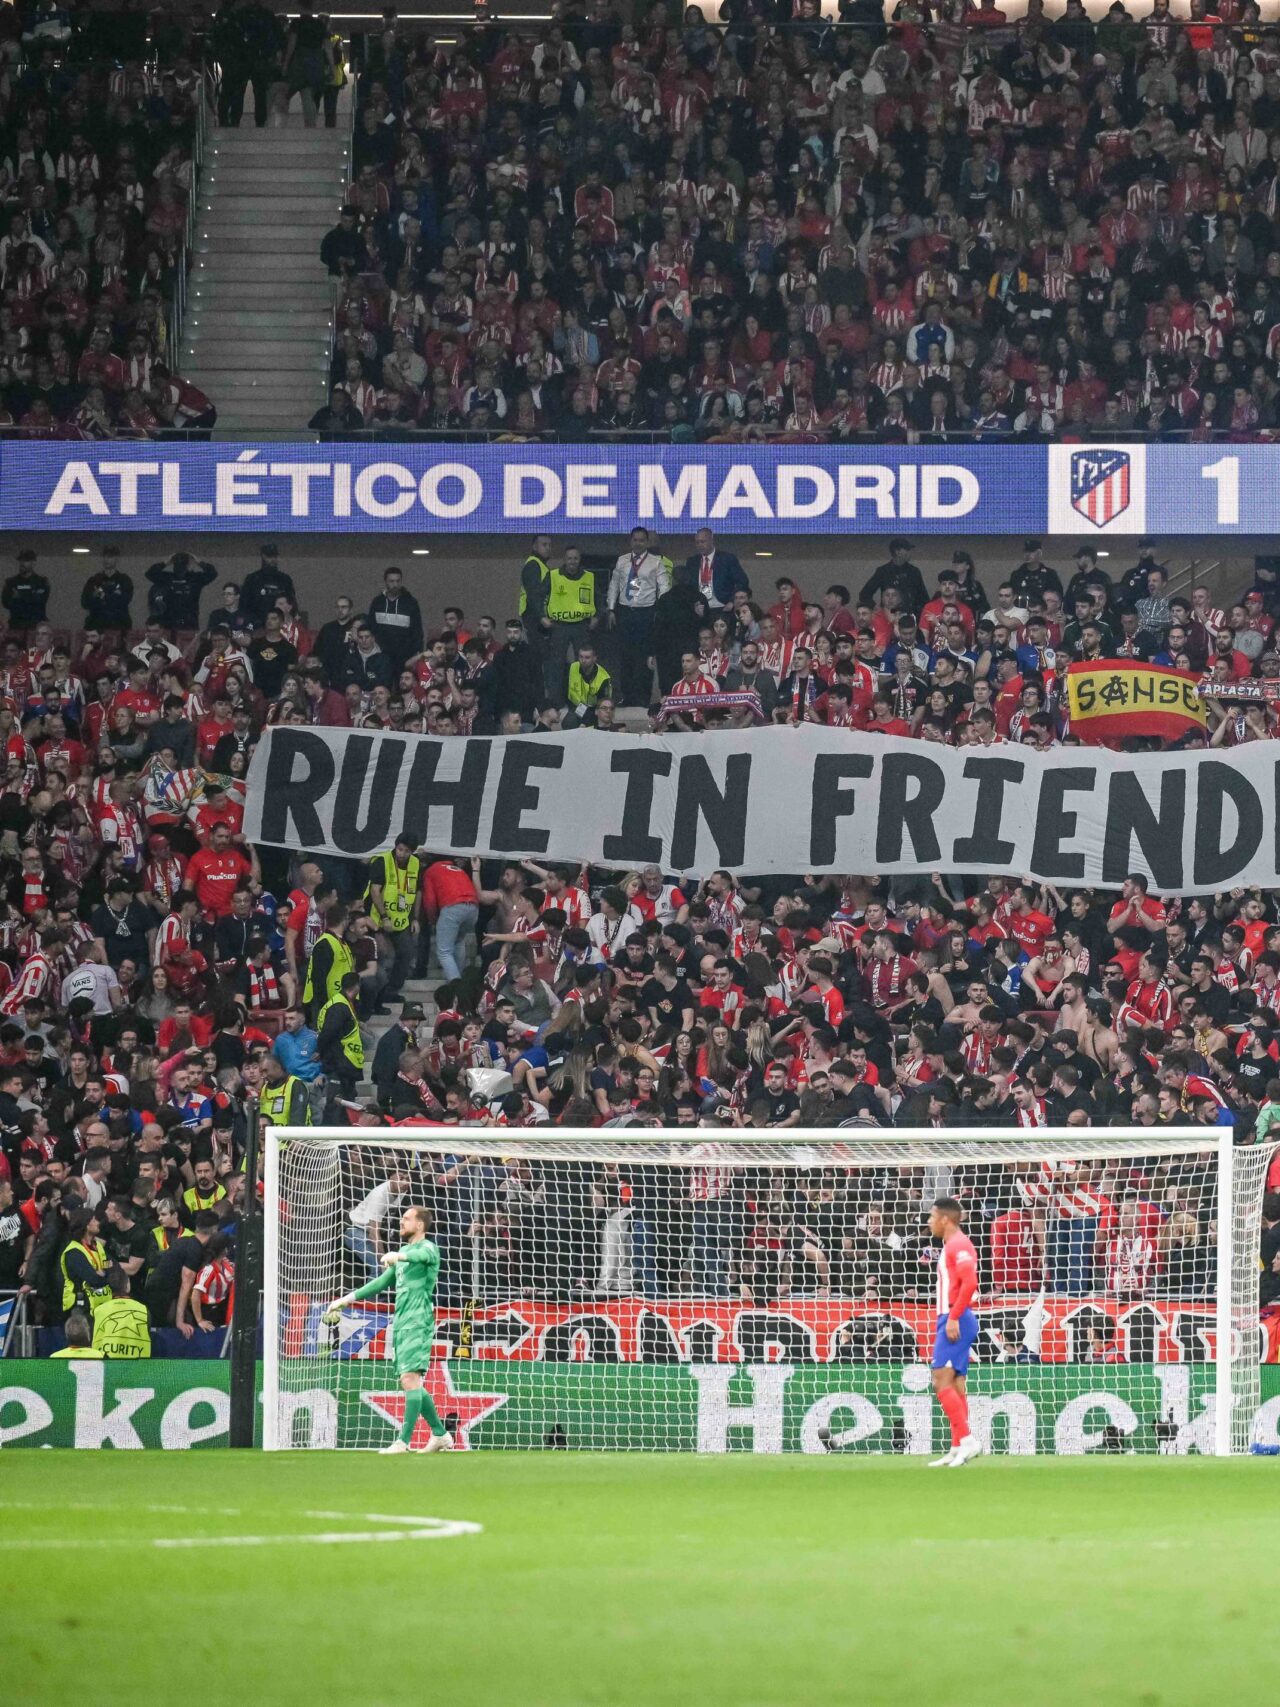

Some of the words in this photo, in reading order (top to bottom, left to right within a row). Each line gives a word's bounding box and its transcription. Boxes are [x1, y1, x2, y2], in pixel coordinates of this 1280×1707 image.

[43, 449, 484, 519] ATLÉTICO
[502, 463, 618, 519] DE
[637, 463, 981, 520] MADRID
[1201, 457, 1240, 524] 1
[261, 729, 565, 854] RUHE
[603, 749, 752, 871] IN
[71, 976, 92, 989] VANS
[99, 1342, 144, 1359] CURITY
